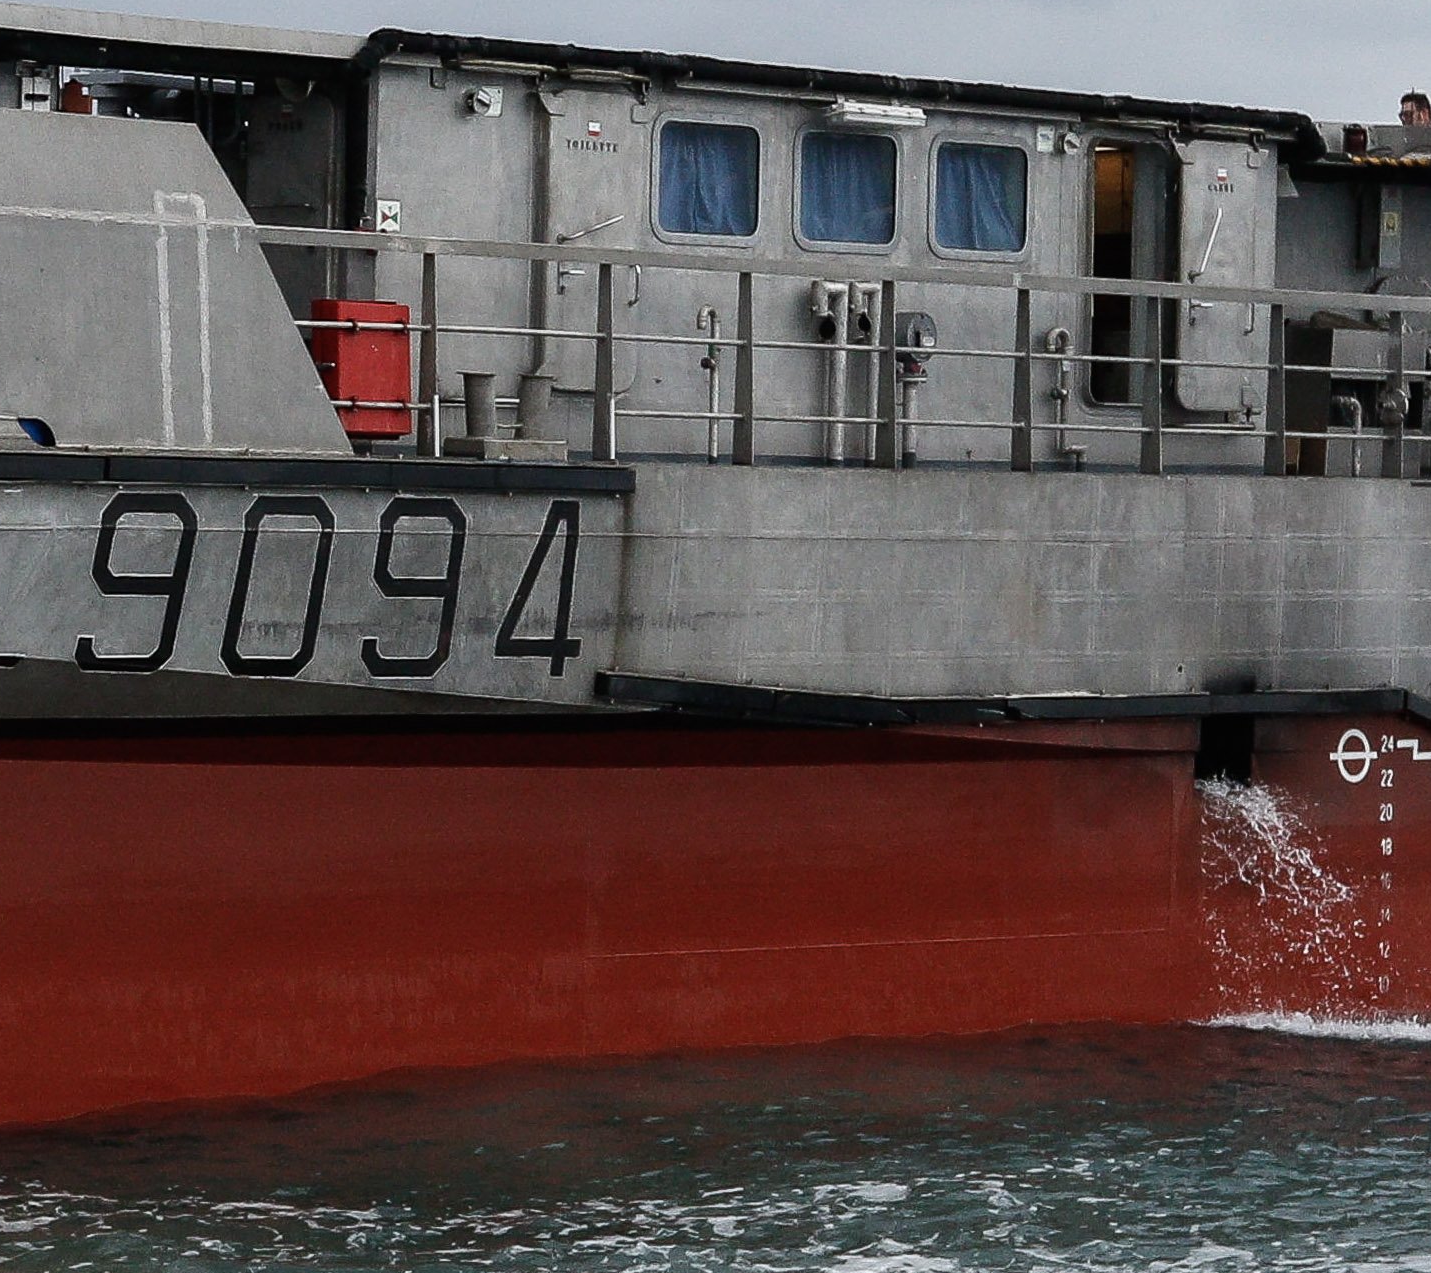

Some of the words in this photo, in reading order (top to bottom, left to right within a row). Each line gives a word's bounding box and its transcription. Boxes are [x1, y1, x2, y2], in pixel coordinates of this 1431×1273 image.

[1380, 734, 1395, 753] 24
[1380, 769, 1394, 788] 22
[1379, 803, 1394, 822] 20
[1380, 837, 1393, 856] 18
[1378, 940, 1391, 959] 12
